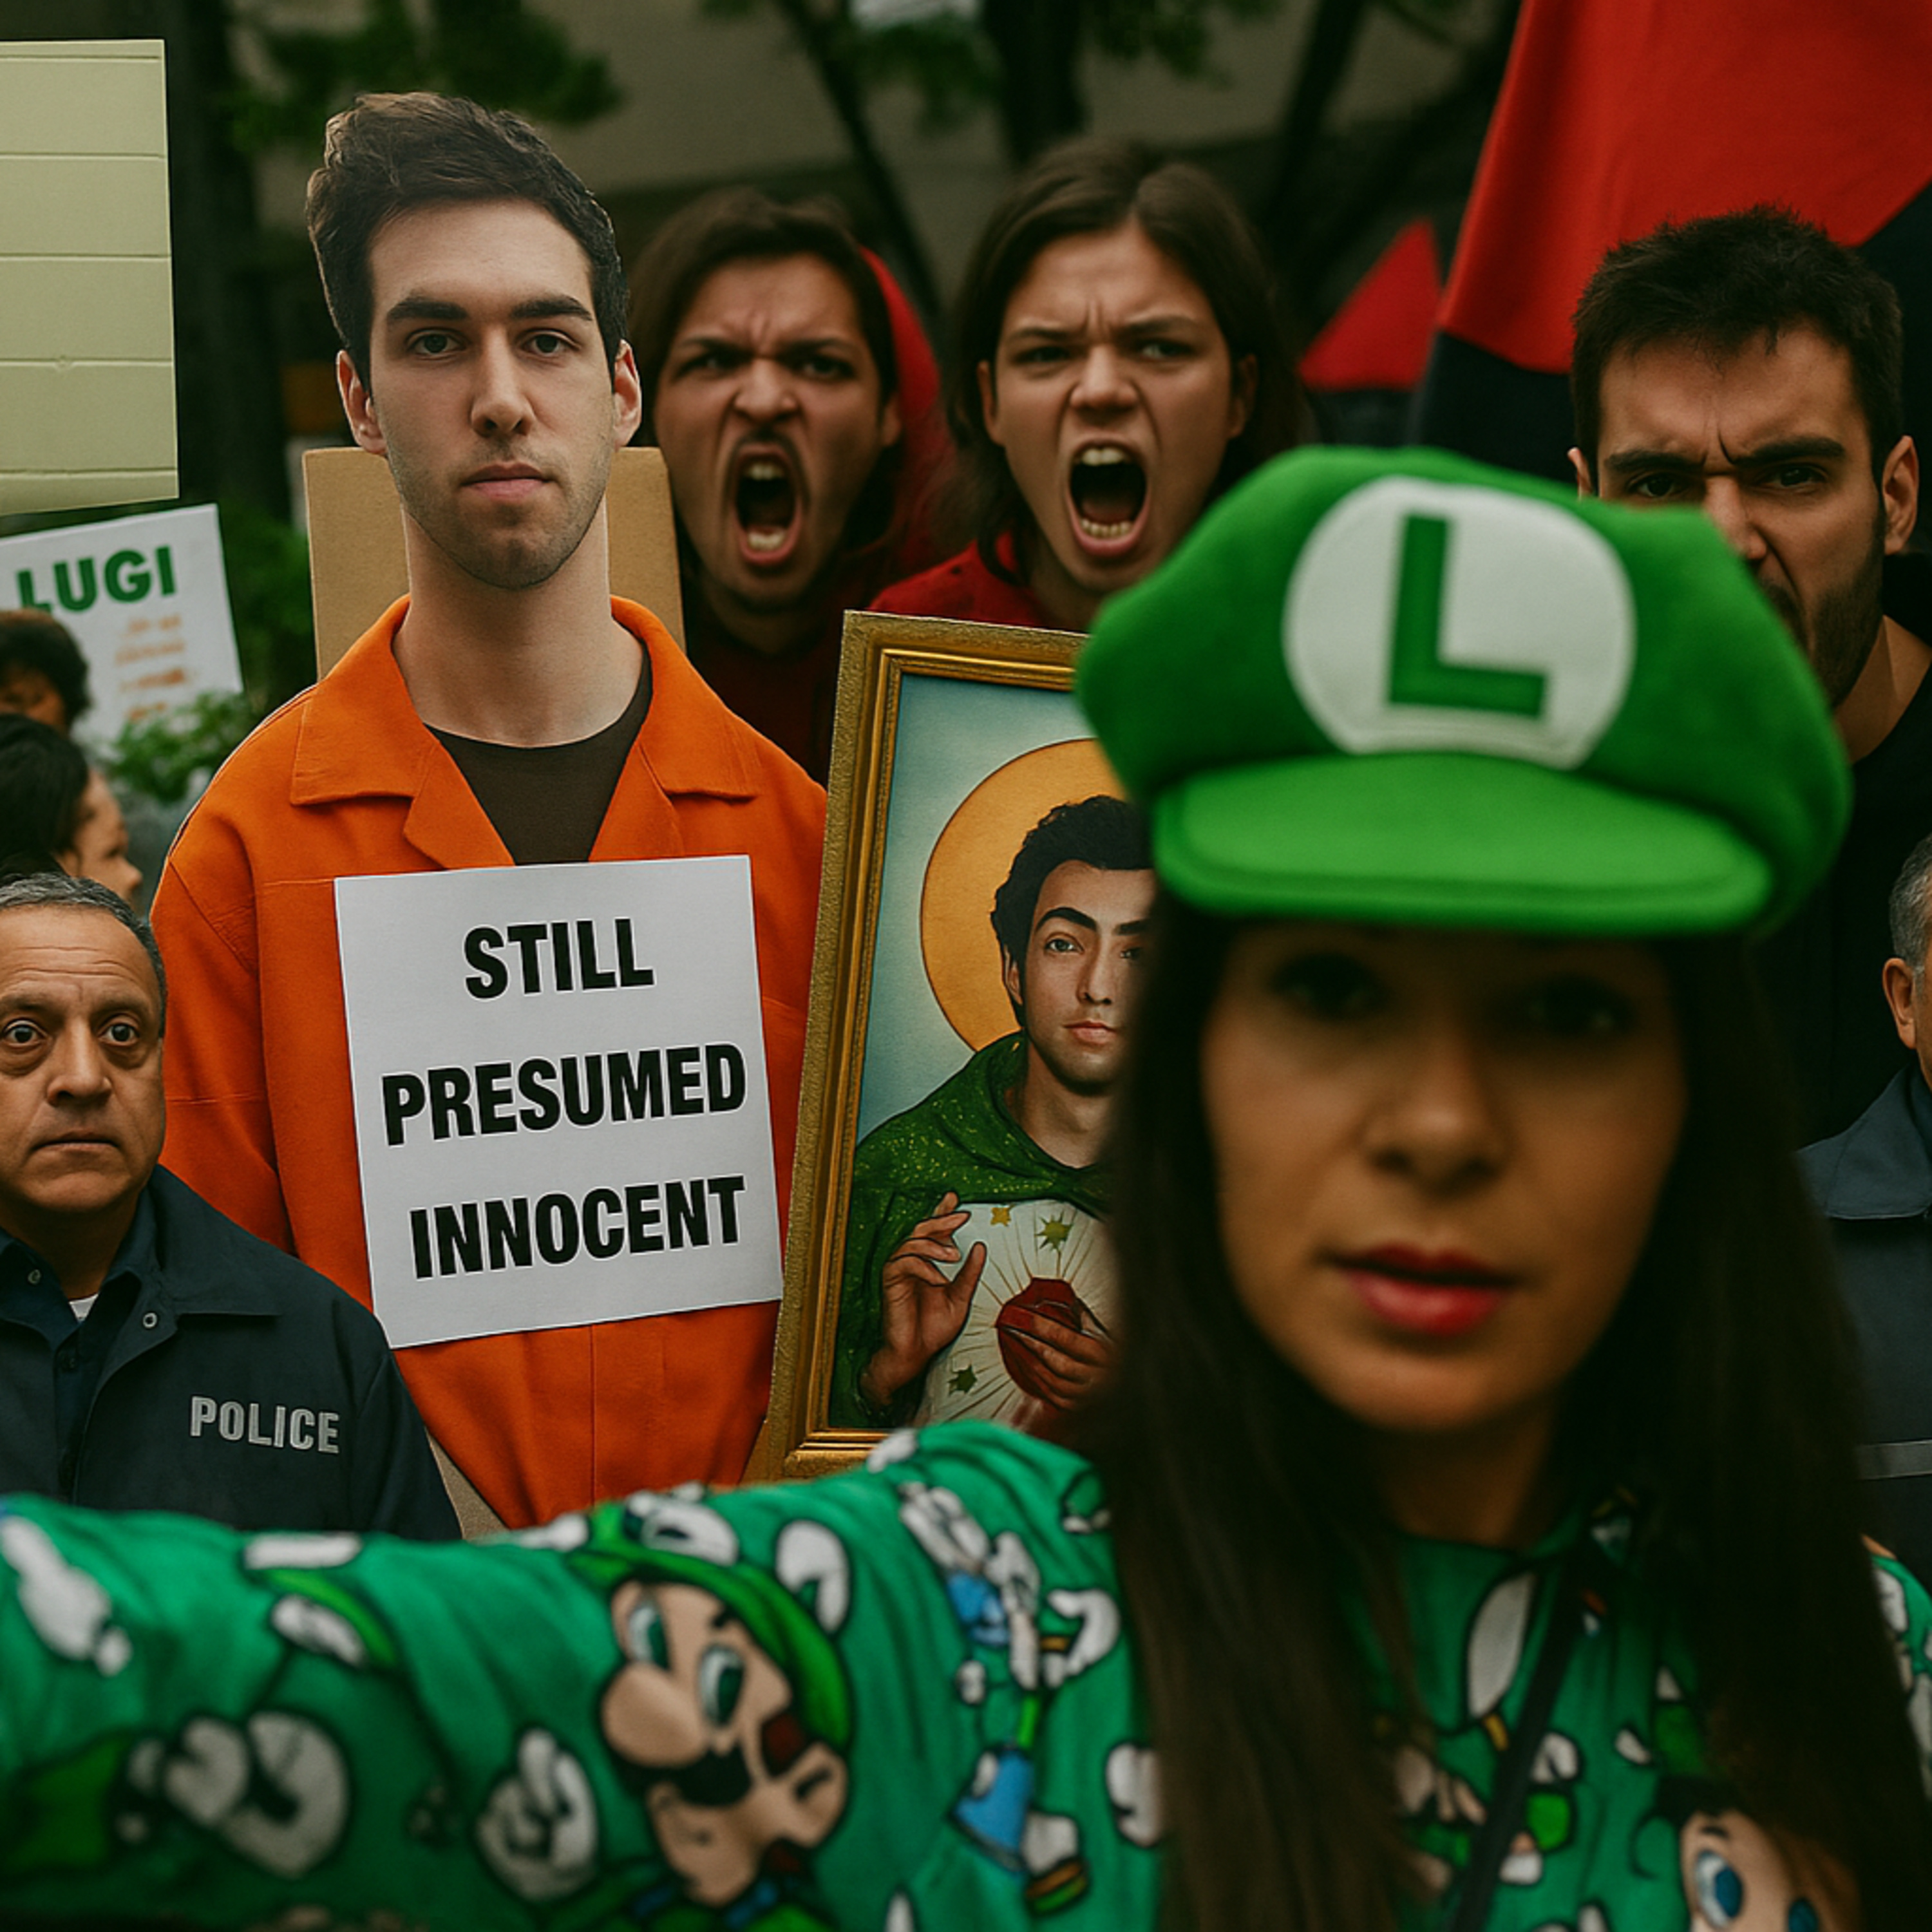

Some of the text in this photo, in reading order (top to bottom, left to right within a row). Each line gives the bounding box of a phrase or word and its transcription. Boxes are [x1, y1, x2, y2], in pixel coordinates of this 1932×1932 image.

[17, 544, 176, 612] LUGI
[1387, 514, 1548, 718] L
[464, 918, 654, 999] STILL
[382, 1043, 746, 1146] PRESUMED
[410, 1175, 745, 1279] INNOCENT
[190, 1396, 339, 1454] POLICE
